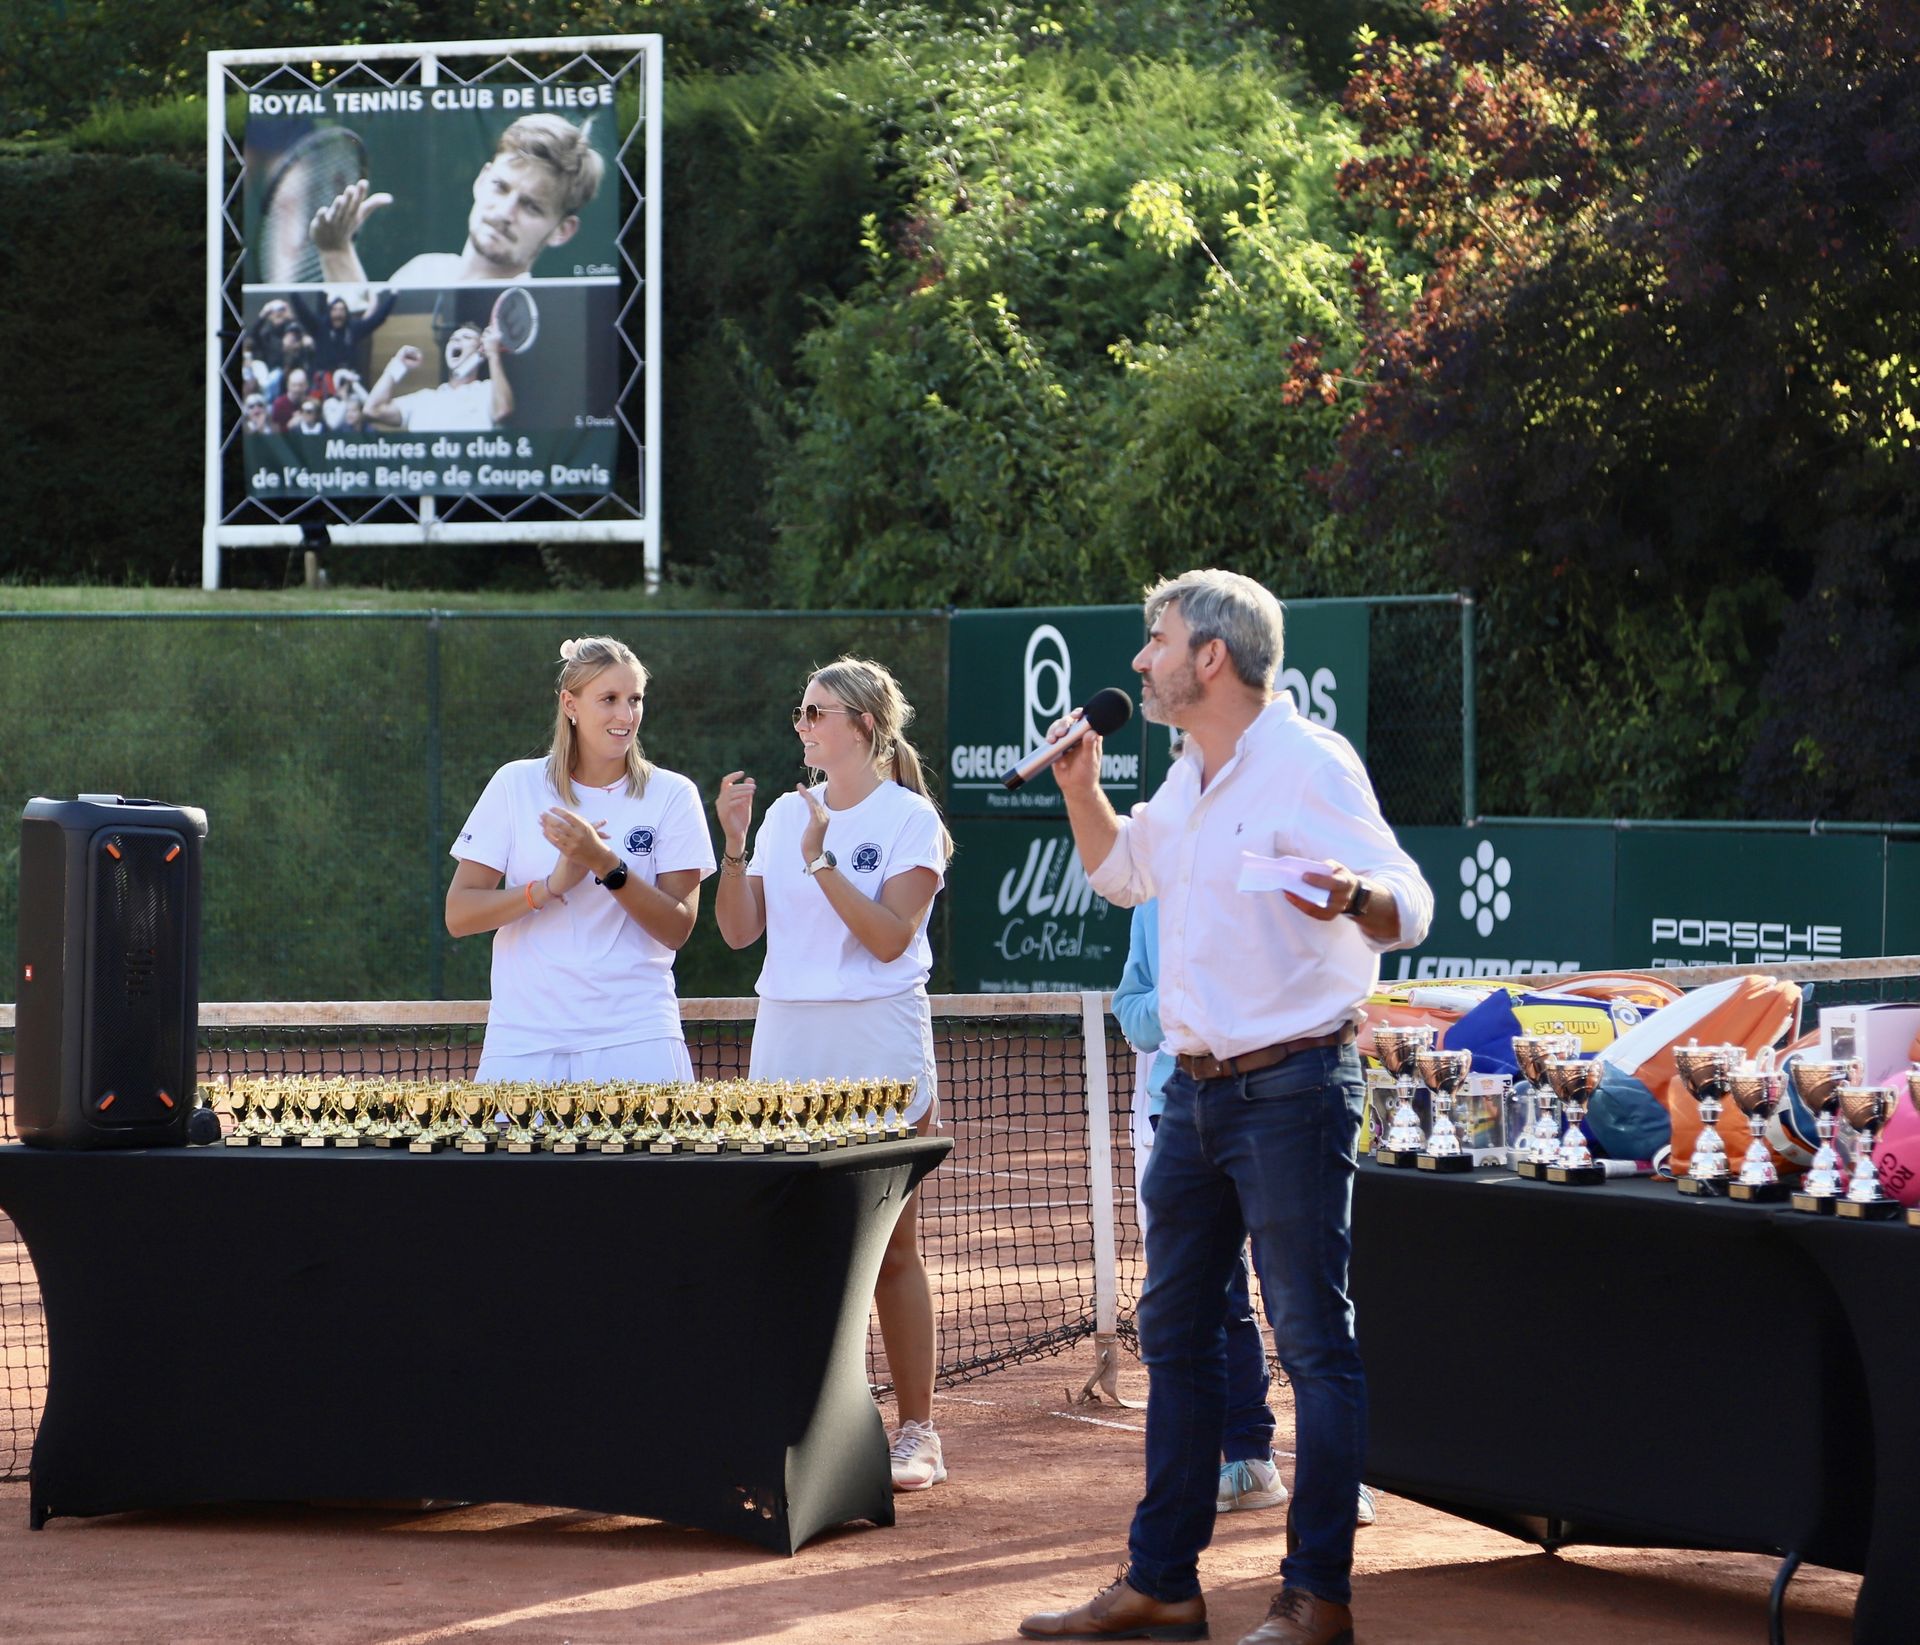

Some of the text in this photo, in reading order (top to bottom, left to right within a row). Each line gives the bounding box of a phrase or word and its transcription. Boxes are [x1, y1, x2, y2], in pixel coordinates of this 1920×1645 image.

[249, 84, 613, 115] ROYAL TENNIS CLUB DE LIEGE
[325, 435, 533, 459] Membres du club &
[252, 463, 609, 492] de l'équipe Belge de Coupe Davis
[1652, 918, 1842, 953] PORSCHE
